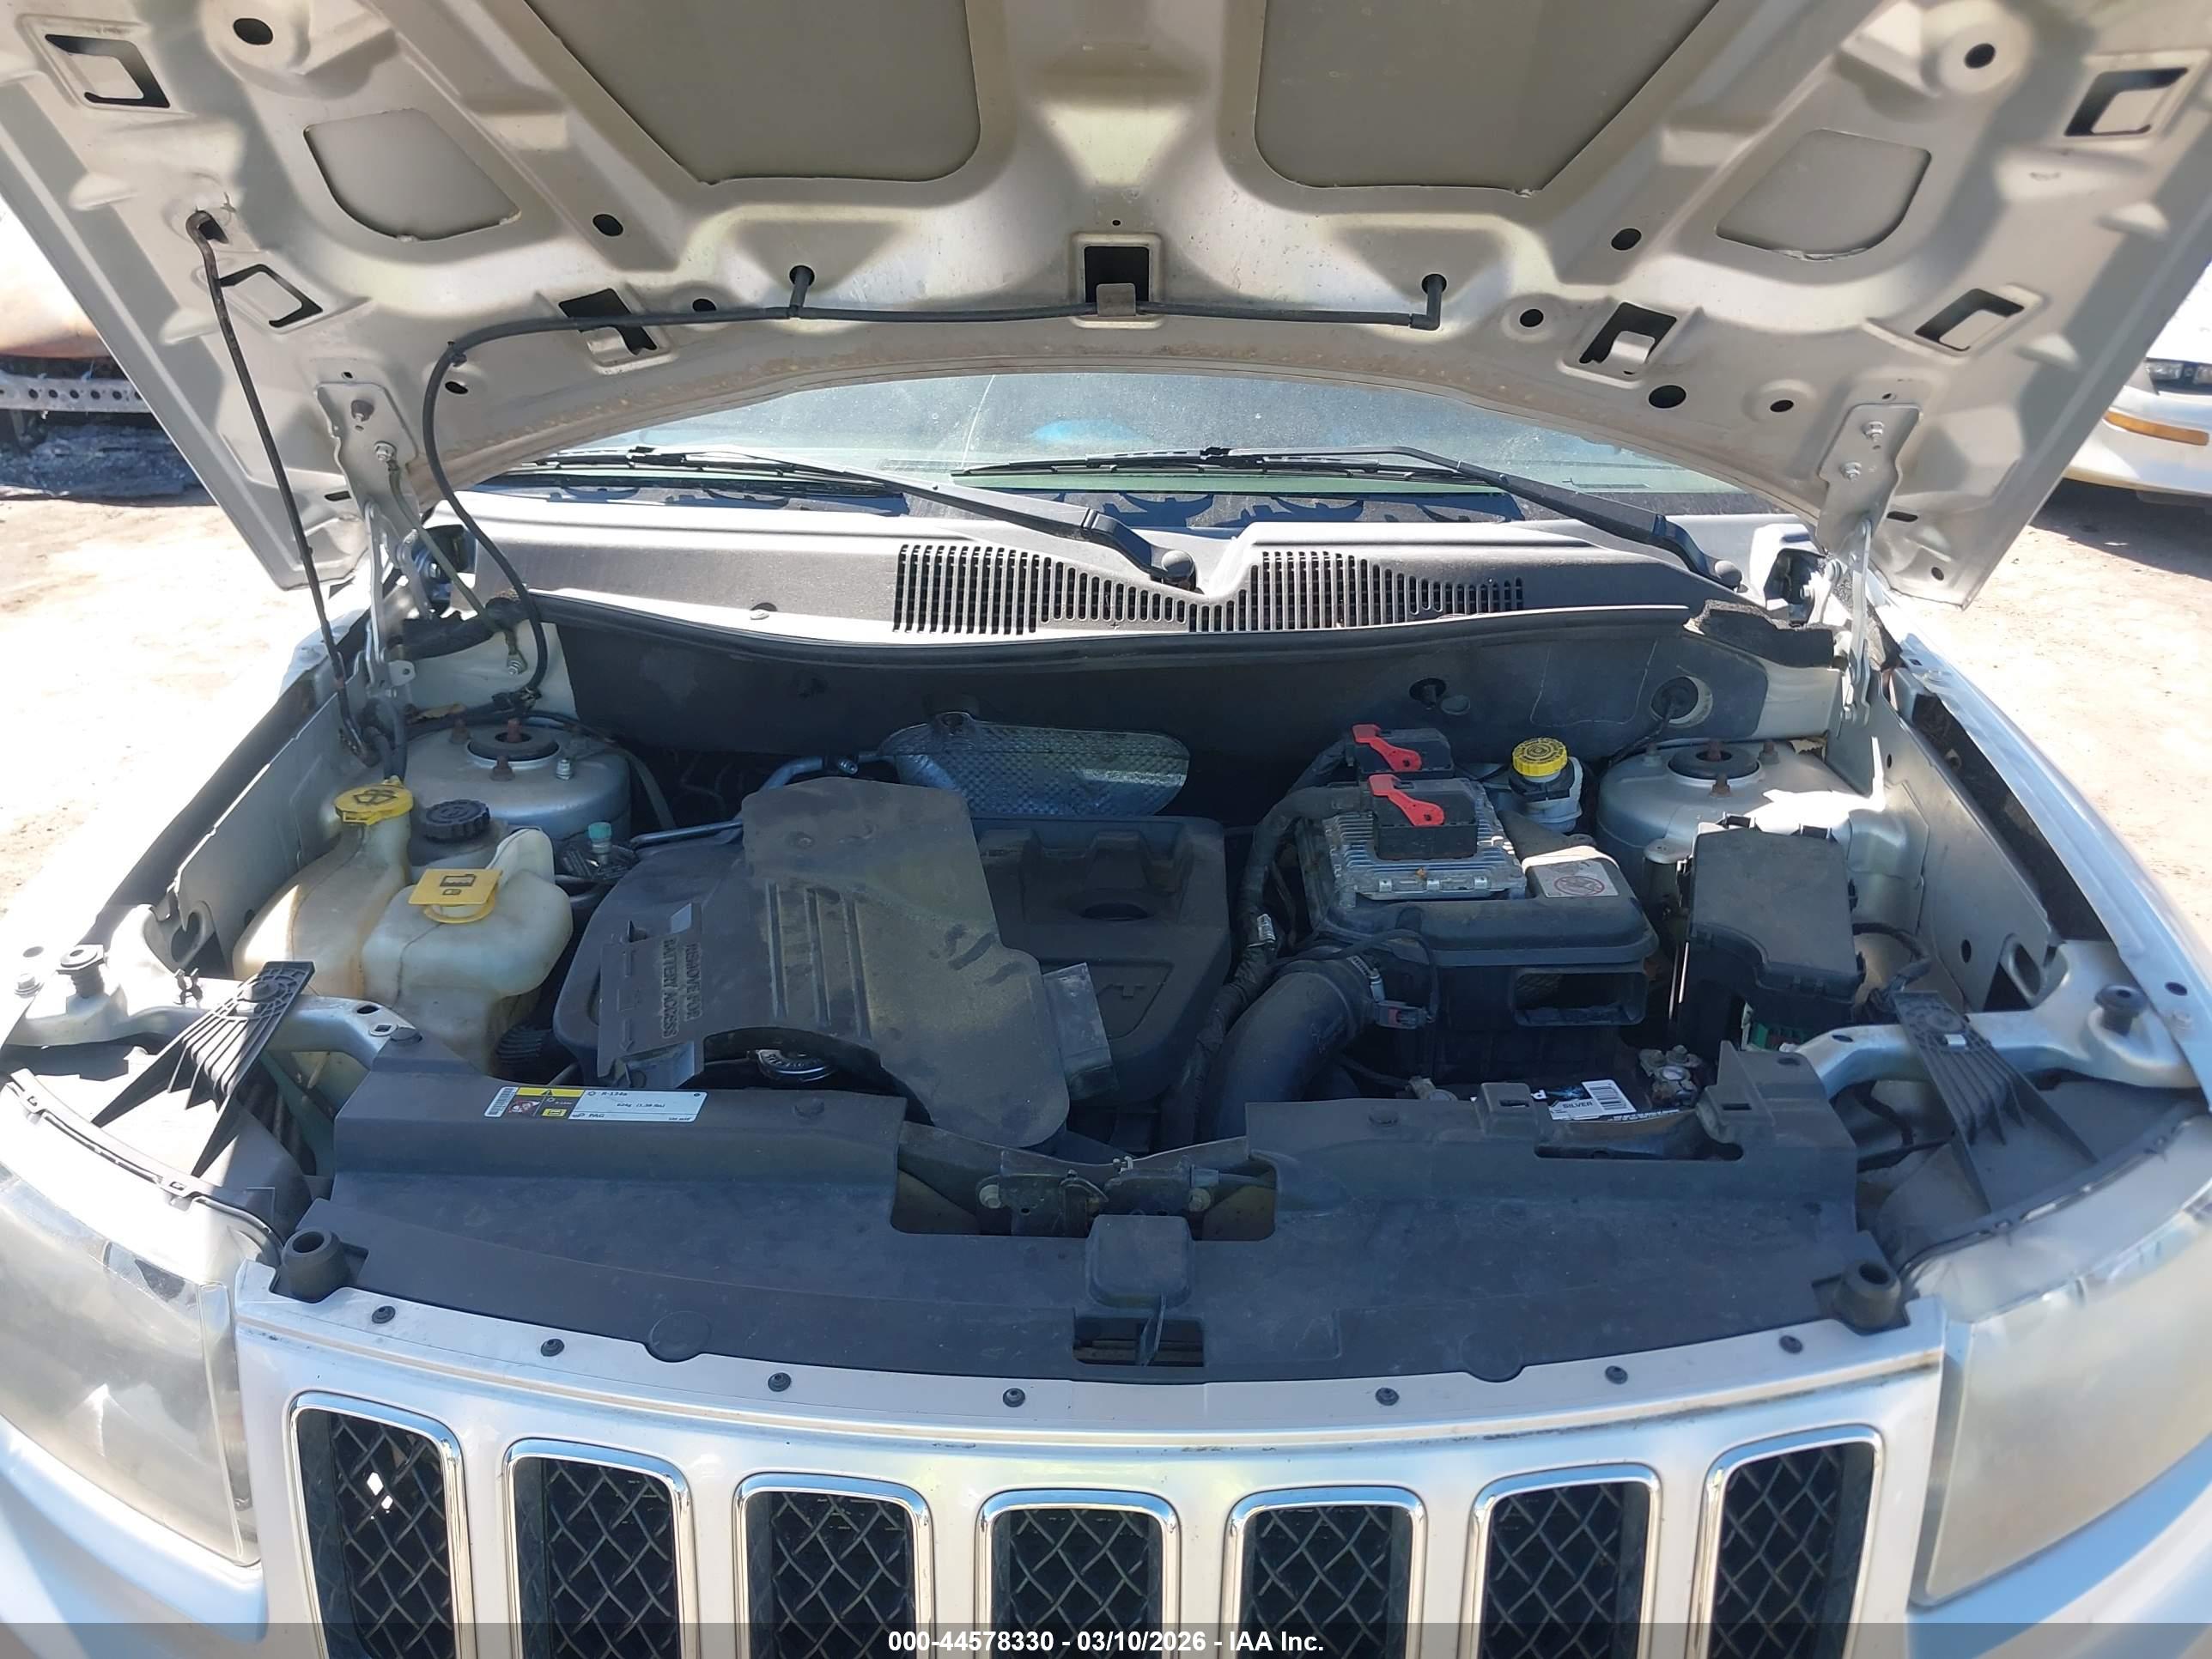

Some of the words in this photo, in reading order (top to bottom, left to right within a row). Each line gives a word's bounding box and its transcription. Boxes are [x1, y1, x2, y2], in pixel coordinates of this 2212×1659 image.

[662, 939, 677, 988] BATTERY
[662, 991, 678, 1038] ACCESS
[685, 992, 702, 1020] FOR
[1562, 1101, 1594, 1109] SILVER
